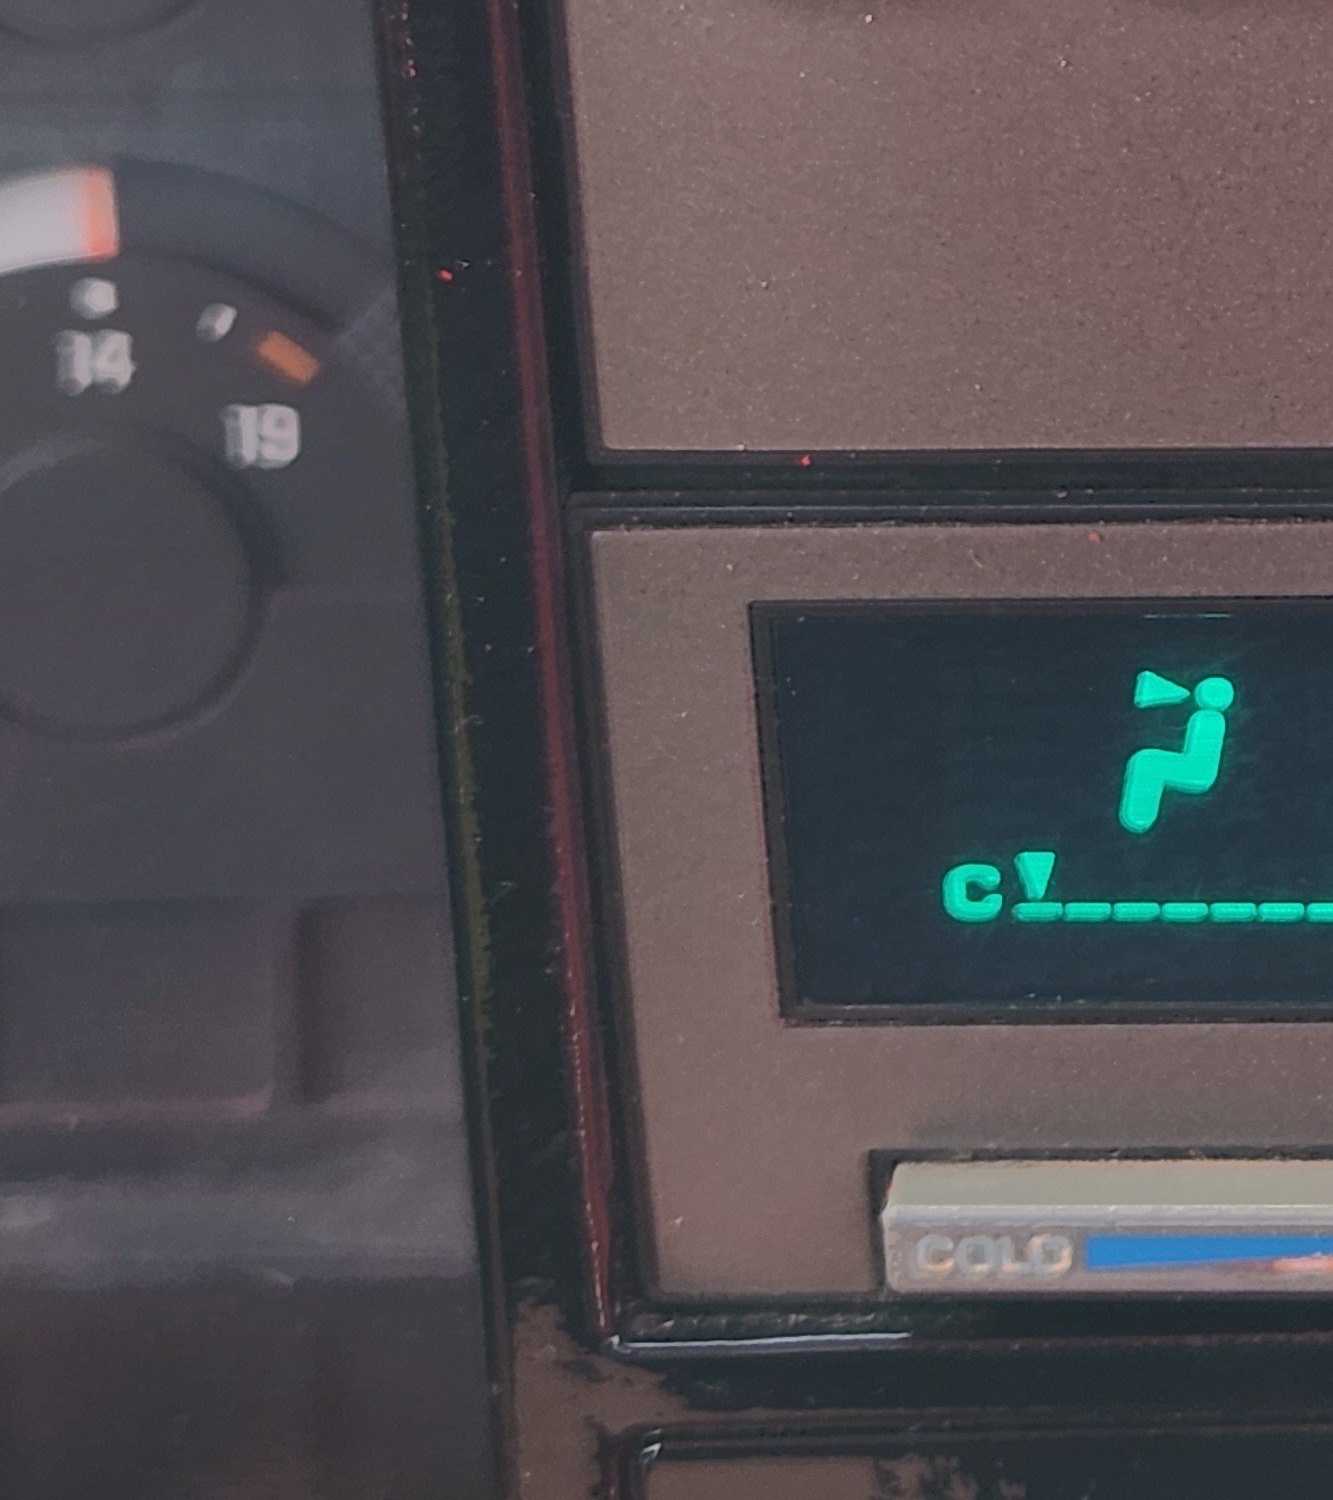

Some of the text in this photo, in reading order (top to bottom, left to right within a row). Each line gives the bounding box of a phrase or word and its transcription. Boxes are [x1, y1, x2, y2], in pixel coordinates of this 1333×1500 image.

[56, 330, 135, 395] 14
[222, 404, 300, 470] 19
[942, 862, 1003, 923] C
[914, 1233, 1075, 1278] COLD
